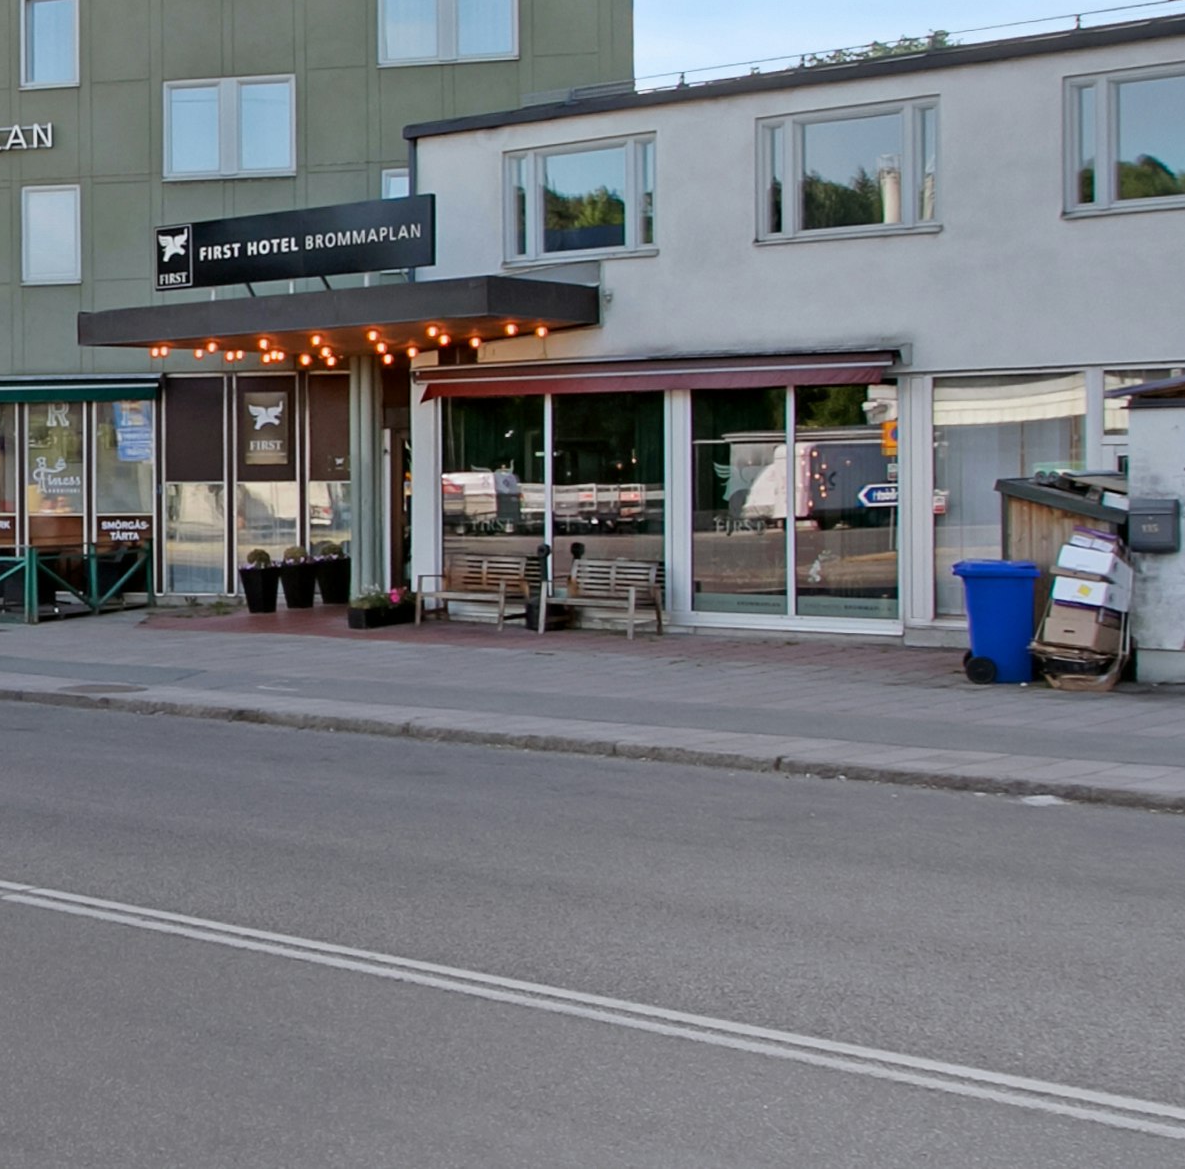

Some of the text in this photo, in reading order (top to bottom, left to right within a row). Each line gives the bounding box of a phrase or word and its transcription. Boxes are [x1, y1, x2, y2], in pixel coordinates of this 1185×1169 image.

[199, 223, 422, 261] FIRST HOTEL BROMMAPLAN
[159, 272, 188, 285] FIRST
[250, 440, 283, 450] FIRST
